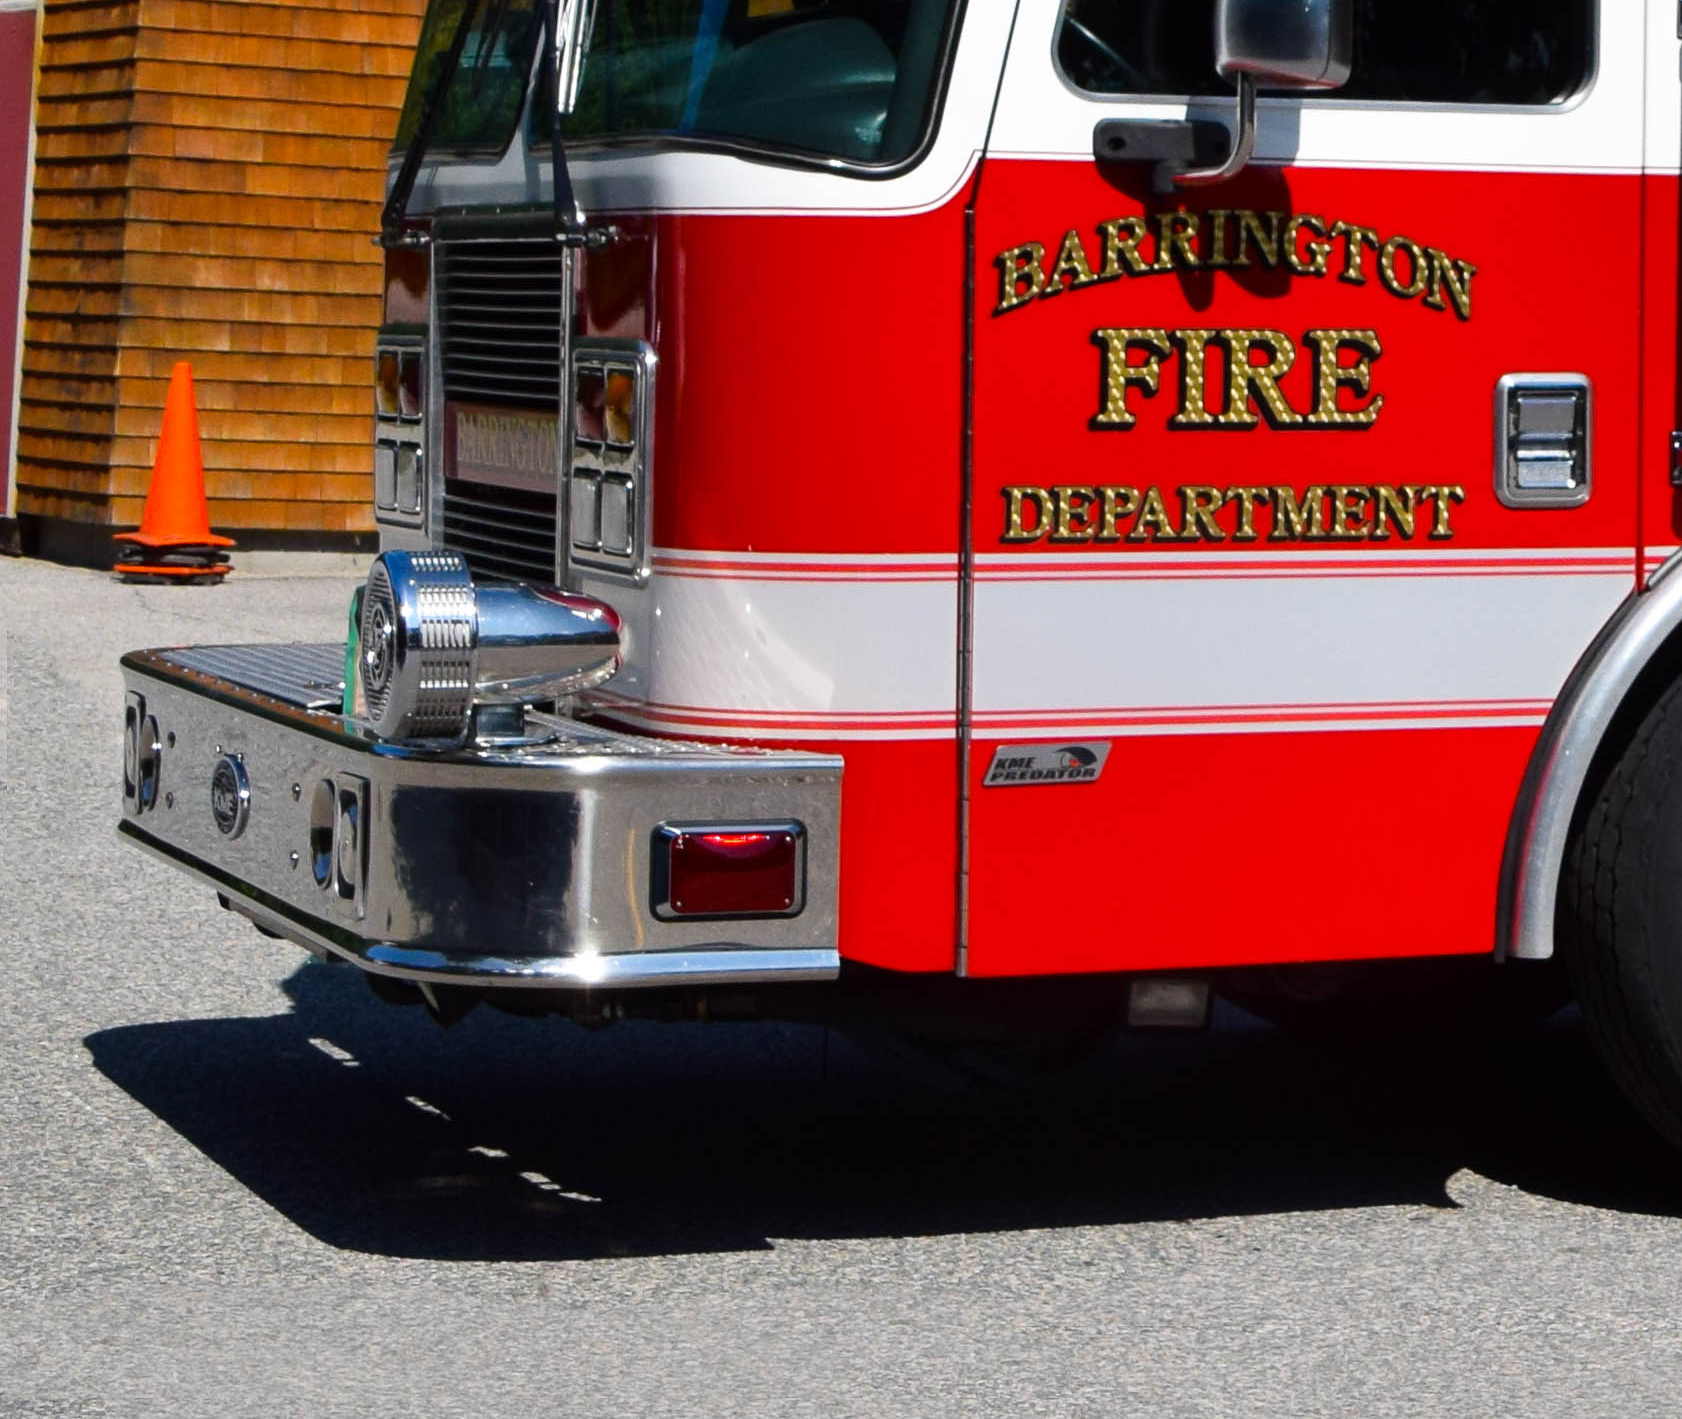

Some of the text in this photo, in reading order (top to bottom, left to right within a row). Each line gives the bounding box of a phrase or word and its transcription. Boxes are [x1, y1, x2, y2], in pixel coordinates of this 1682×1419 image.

[992, 209, 1476, 320] BARRINGTON
[1089, 327, 1385, 431] FIRE
[999, 485, 1467, 544] DEPARTMENT
[990, 768, 1097, 782] PREDATOR
[995, 756, 1036, 770] KME
